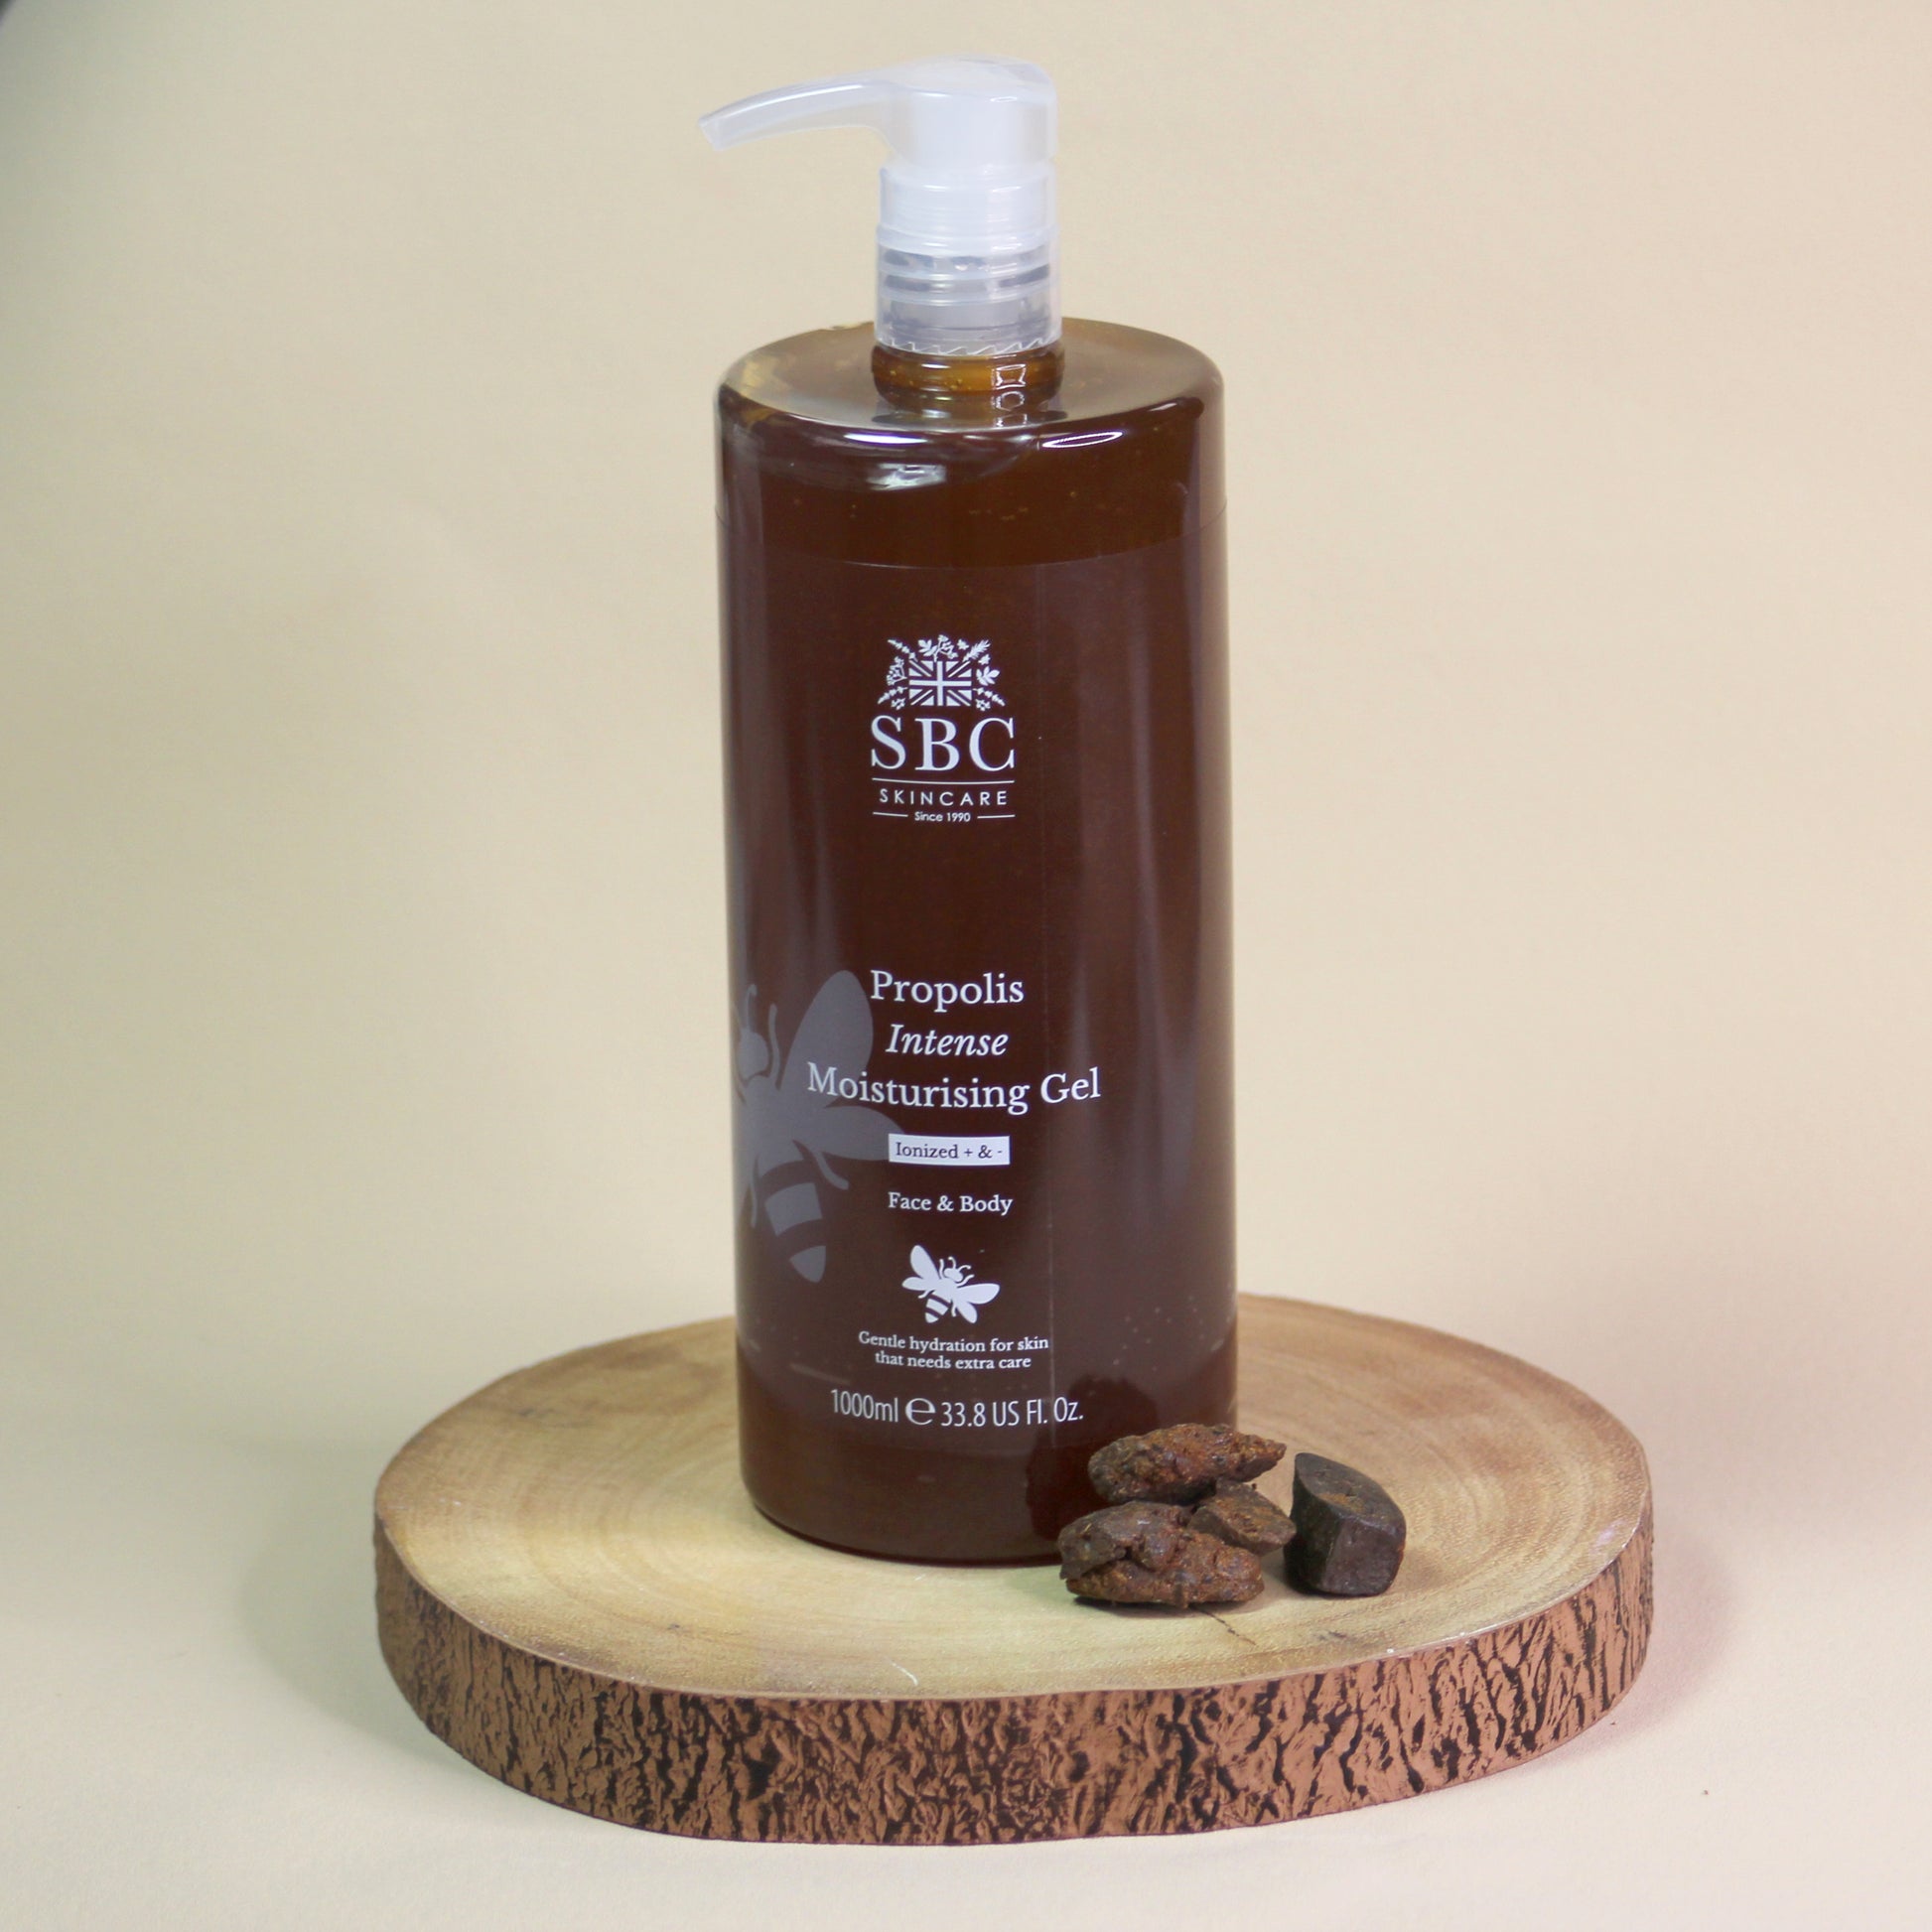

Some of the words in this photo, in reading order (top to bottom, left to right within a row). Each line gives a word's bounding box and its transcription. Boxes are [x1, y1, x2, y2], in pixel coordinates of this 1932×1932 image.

[871, 715, 1015, 771] SBC
[880, 788, 1007, 806] SKINCARE
[914, 811, 943, 822] Since
[947, 812, 971, 822] 1990
[870, 970, 1025, 1013] Propolis
[885, 1024, 1009, 1056] Intense
[807, 1061, 1031, 1115] Moisturising
[1040, 1066, 1101, 1103] Gel
[896, 1142, 958, 1159] Ionized
[978, 1146, 992, 1159] &
[888, 1192, 931, 1211] Face
[936, 1195, 954, 1212] &
[959, 1194, 1013, 1216] Body
[858, 1330, 905, 1349] Gentle
[909, 1336, 985, 1354] hydration
[990, 1338, 1015, 1351] for
[1018, 1336, 1049, 1350] skin
[875, 1350, 903, 1366] that
[907, 1355, 951, 1369] needs
[955, 1357, 995, 1369] extra
[998, 1357, 1032, 1369] care
[830, 1389, 898, 1423] 1000ml
[941, 1401, 987, 1428] 33.8
[992, 1400, 1020, 1427] US
[1053, 1396, 1084, 1423] Oz.
